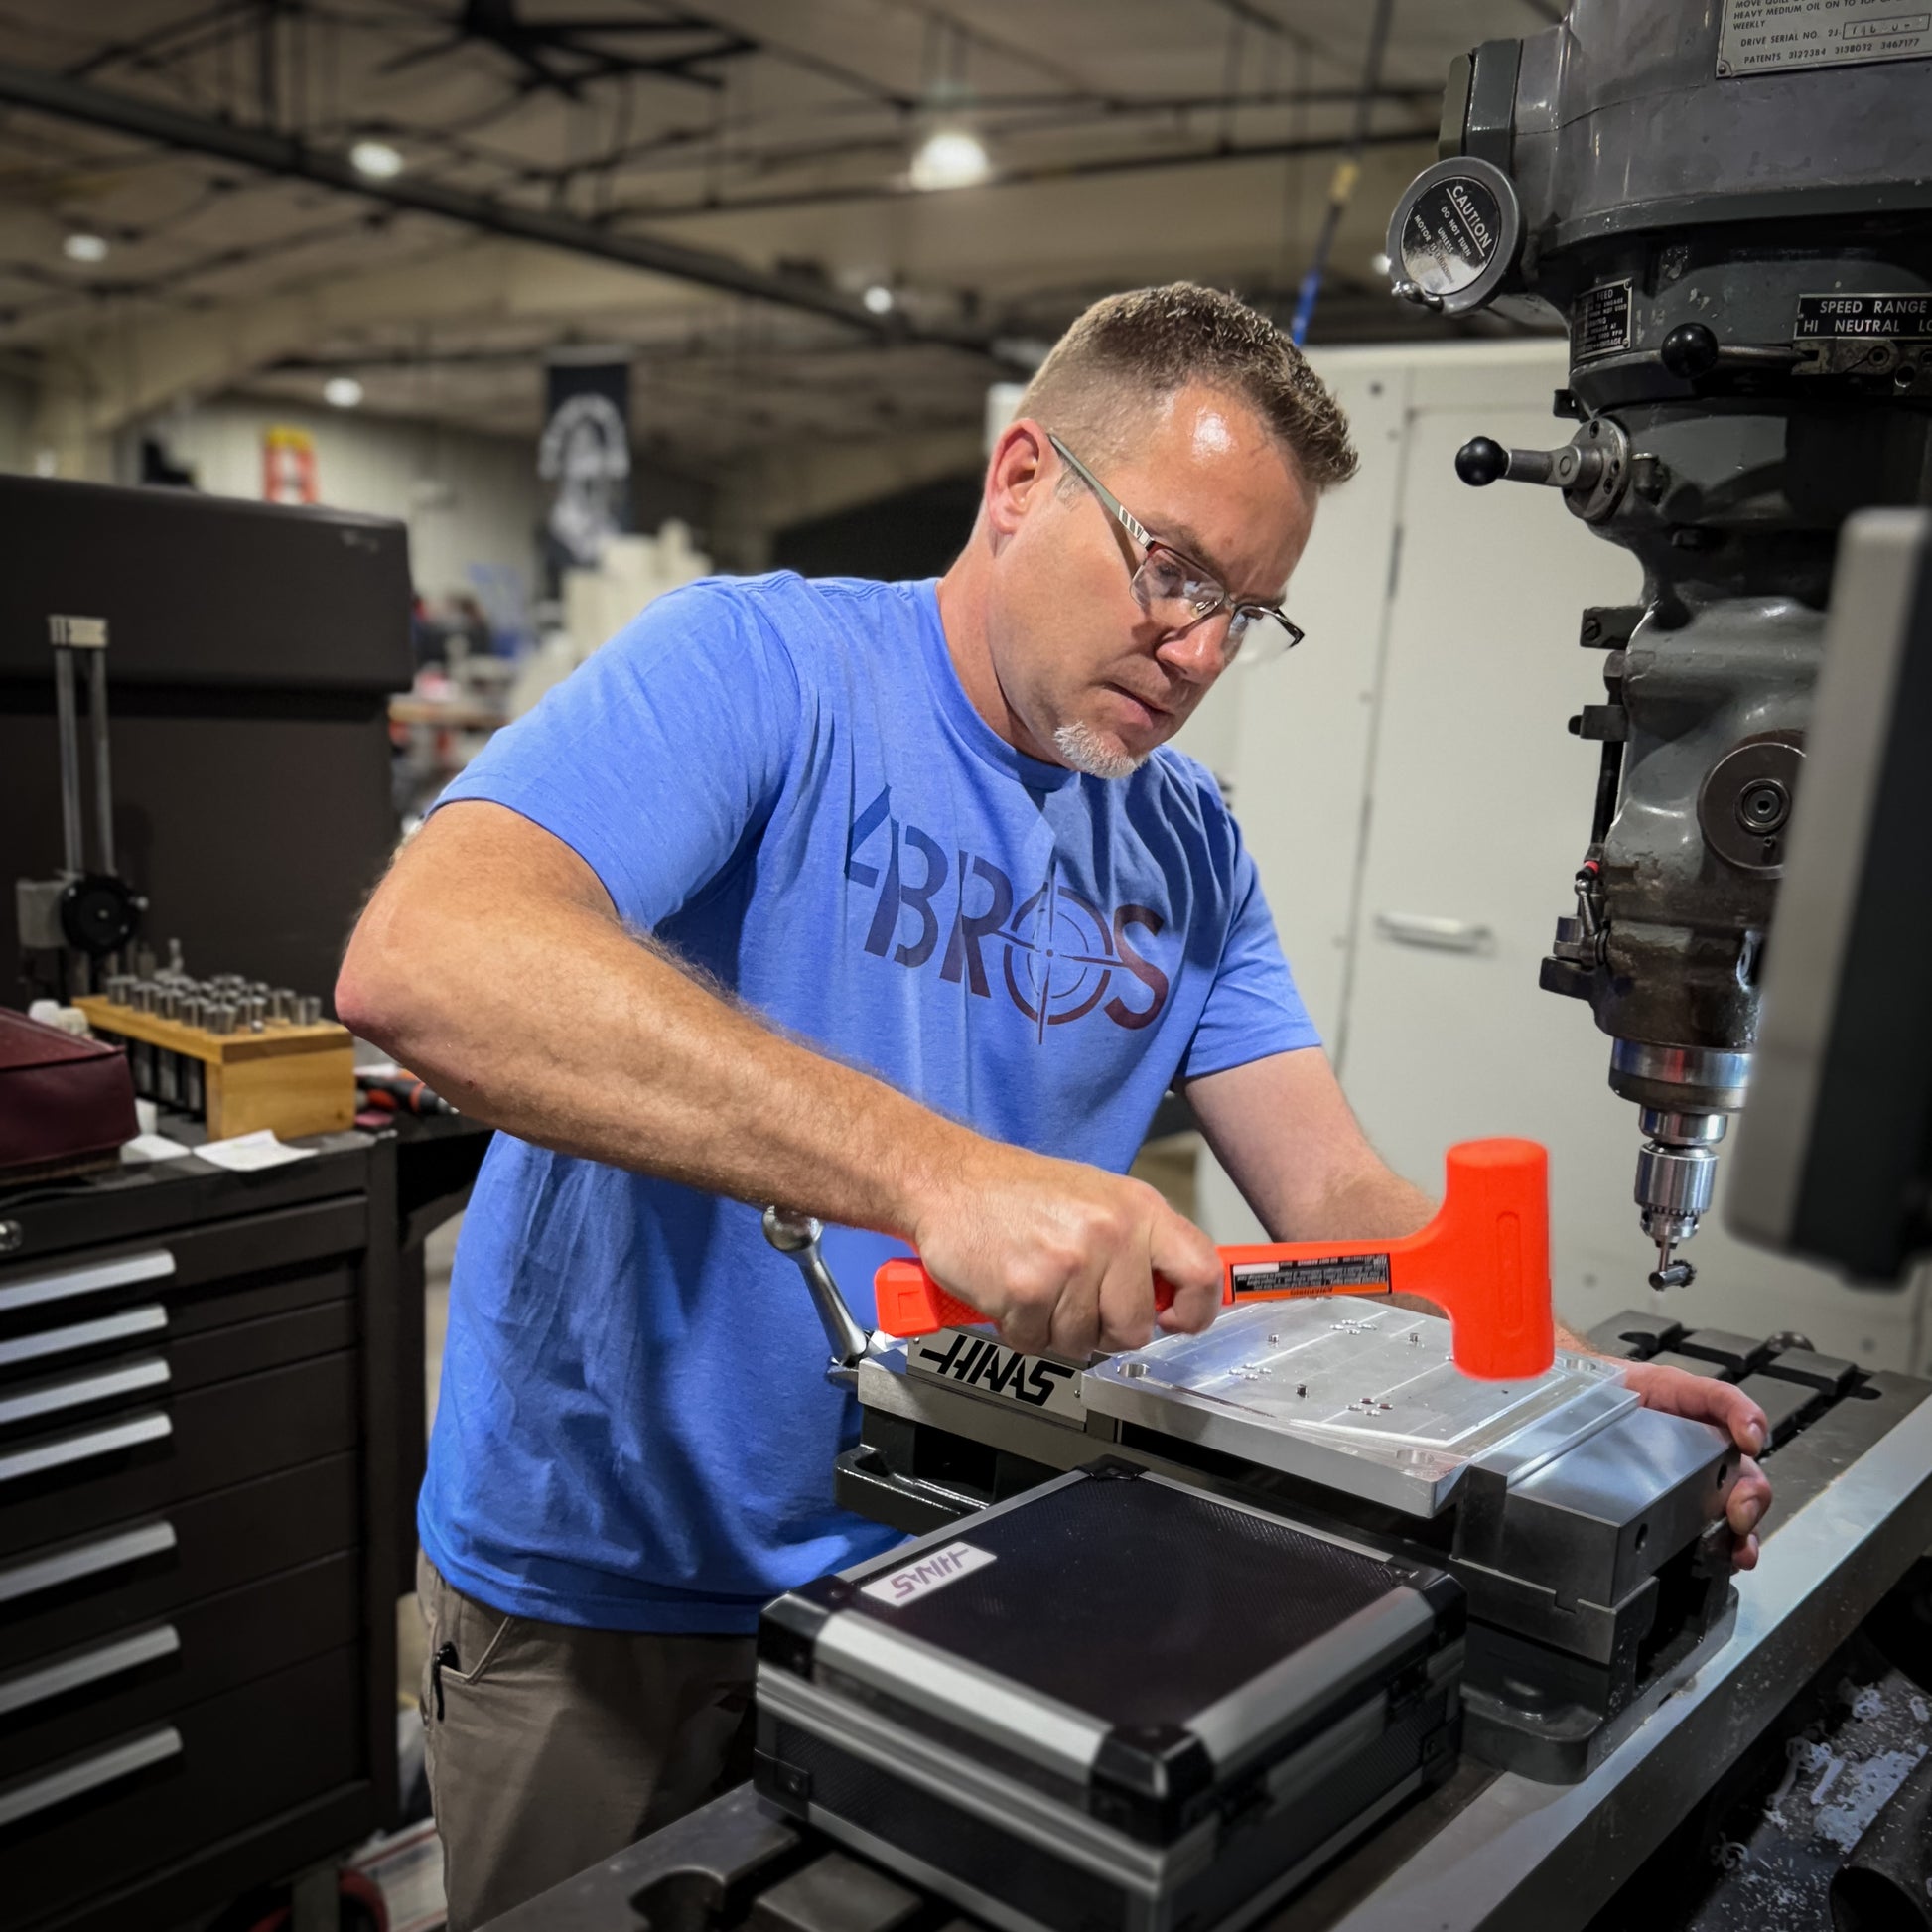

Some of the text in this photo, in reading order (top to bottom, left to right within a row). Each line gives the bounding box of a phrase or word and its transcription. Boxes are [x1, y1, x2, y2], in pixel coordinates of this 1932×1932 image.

[1734, 9, 1763, 20] HEAVY
[1766, 5, 1802, 16] MEDIUM
[1807, 2, 1820, 11] OIL
[1733, 20, 1765, 31] WEEKLY
[1740, 36, 1767, 47] DRIVE
[1770, 33, 1799, 44] SERIAL
[1743, 52, 1781, 64] PATENTS
[1452, 185, 1492, 249] CAUTION
[1414, 214, 1432, 242] MOTOR
[1441, 206, 1471, 257] DO NOT TURN
[1437, 226, 1454, 254] UNLESS
[1819, 300, 1928, 314] SPEED RANGE
[1803, 319, 1819, 333] HI
[1834, 319, 1900, 333] NEUTRAL
[919, 1334, 1075, 1406] HAAS
